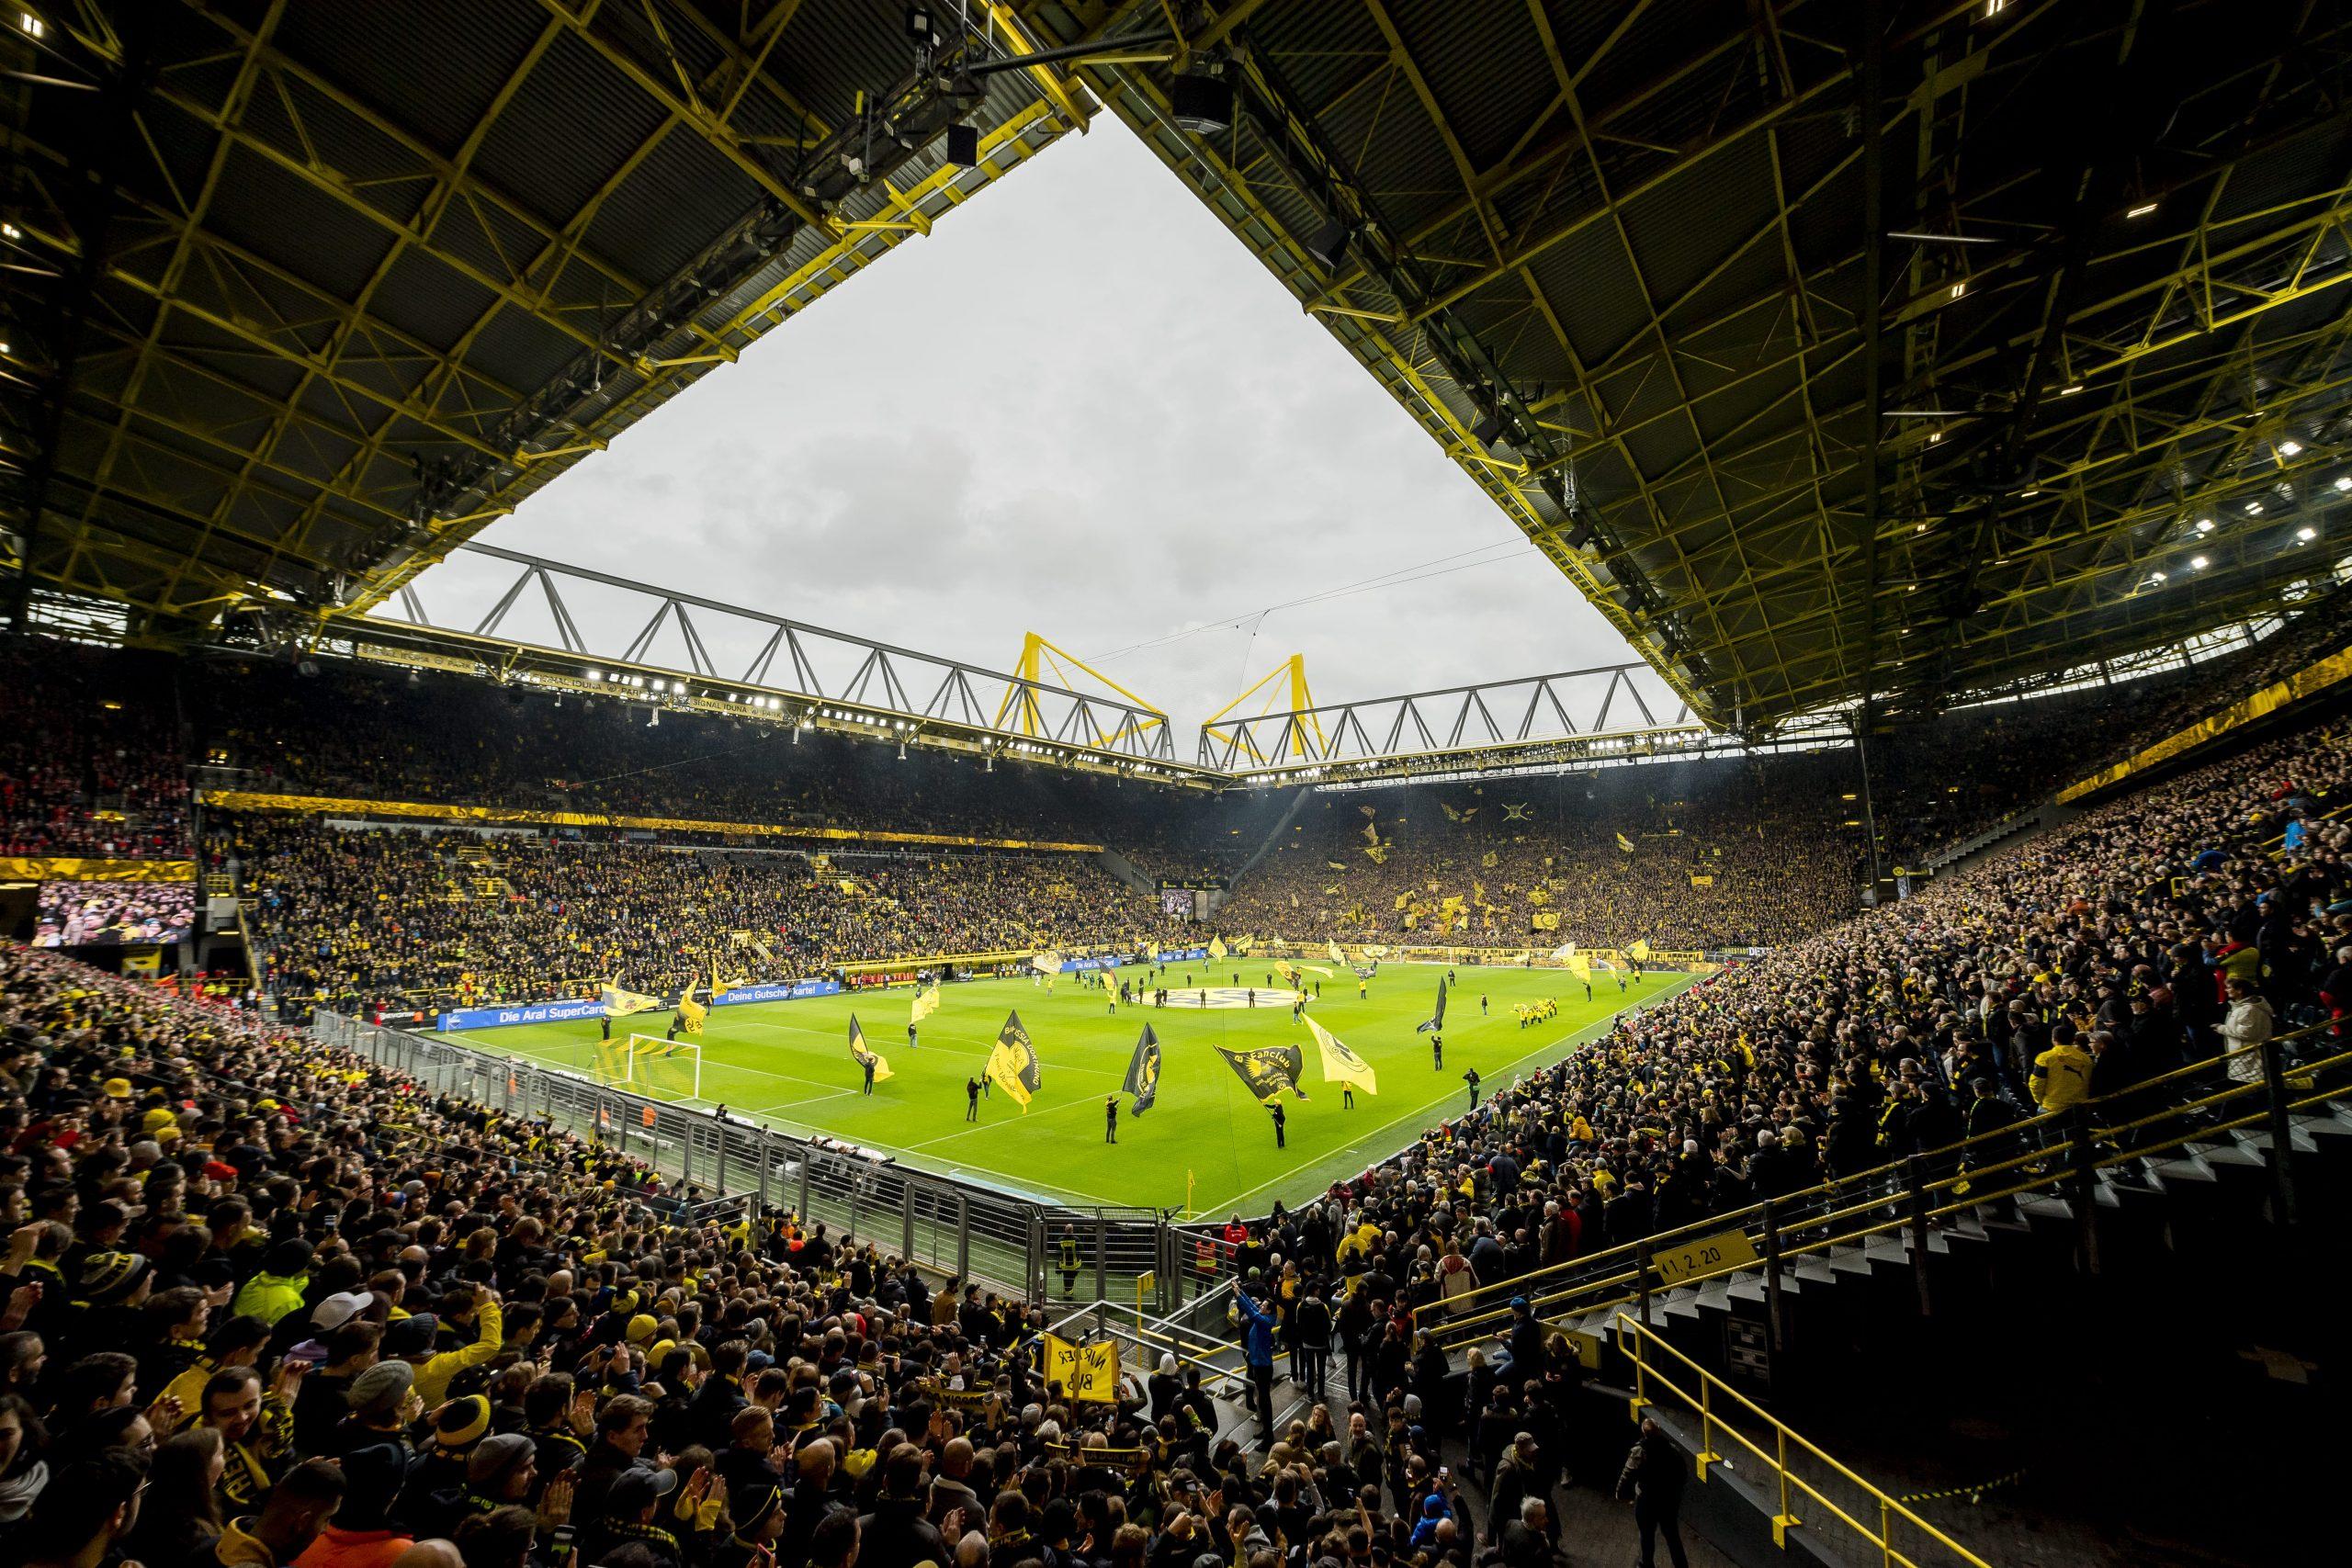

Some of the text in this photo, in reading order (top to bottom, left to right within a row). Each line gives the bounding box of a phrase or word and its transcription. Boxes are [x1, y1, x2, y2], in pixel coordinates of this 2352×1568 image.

[571, 680, 602, 691] IDUNA
[693, 699, 722, 709] SIGNAL
[723, 705, 747, 713] IDUNA
[728, 991, 752, 1002] Deine
[754, 985, 816, 999] Gutschekarte!
[499, 1005, 605, 1022] Die Aral SuperCard
[1250, 1050, 1291, 1068] Fanclub
